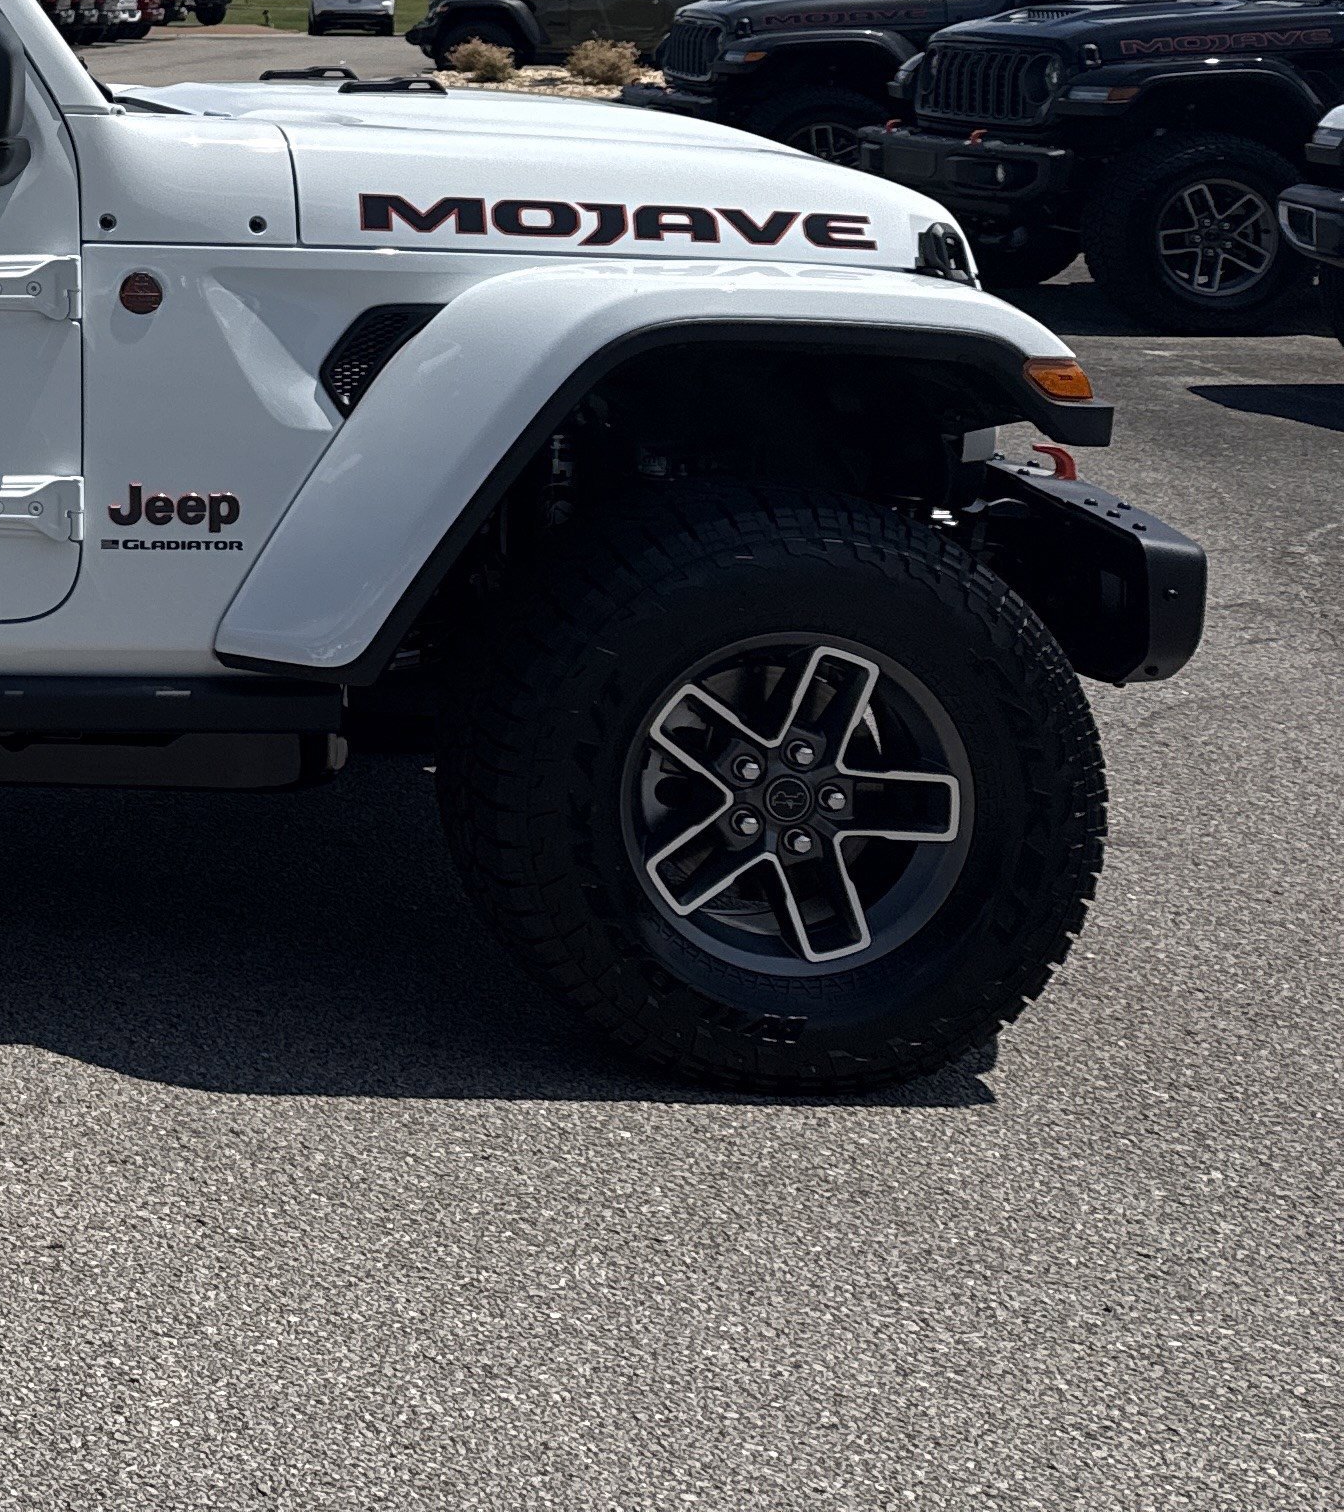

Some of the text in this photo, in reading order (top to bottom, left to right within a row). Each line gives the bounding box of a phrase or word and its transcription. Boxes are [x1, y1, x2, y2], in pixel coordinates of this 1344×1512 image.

[764, 9, 929, 27] MOJAVE
[1120, 29, 1333, 55] MOJAVE
[359, 193, 878, 251] MOJAVE
[108, 481, 240, 533] Jeep
[122, 539, 243, 550] GLADIATOR
